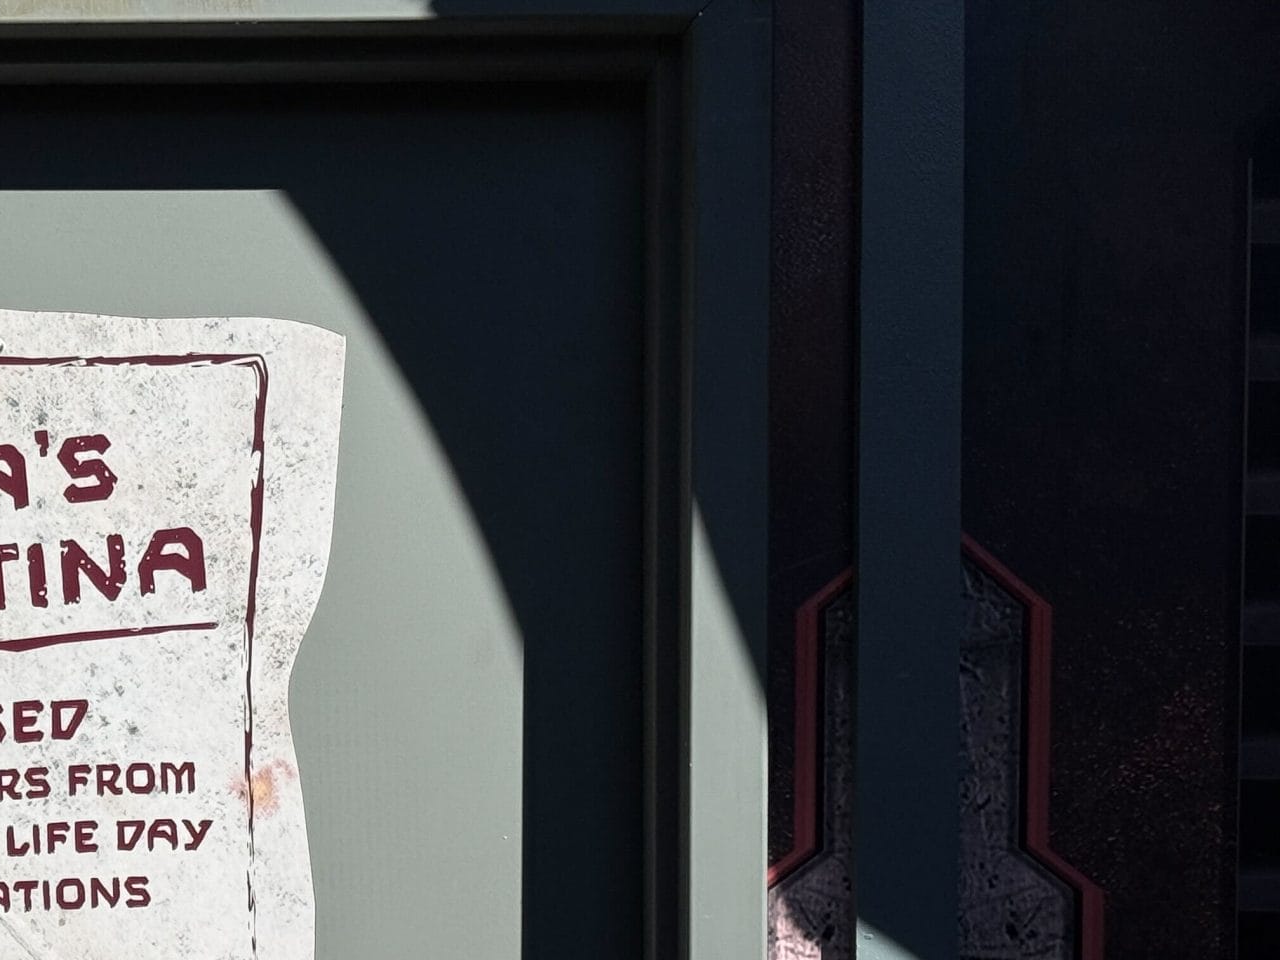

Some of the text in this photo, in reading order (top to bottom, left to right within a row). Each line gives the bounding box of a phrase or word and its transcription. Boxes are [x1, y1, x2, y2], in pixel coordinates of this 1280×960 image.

[68, 762, 196, 796] FROM
[6, 820, 99, 856] LIFE
[116, 819, 213, 851] DAY
